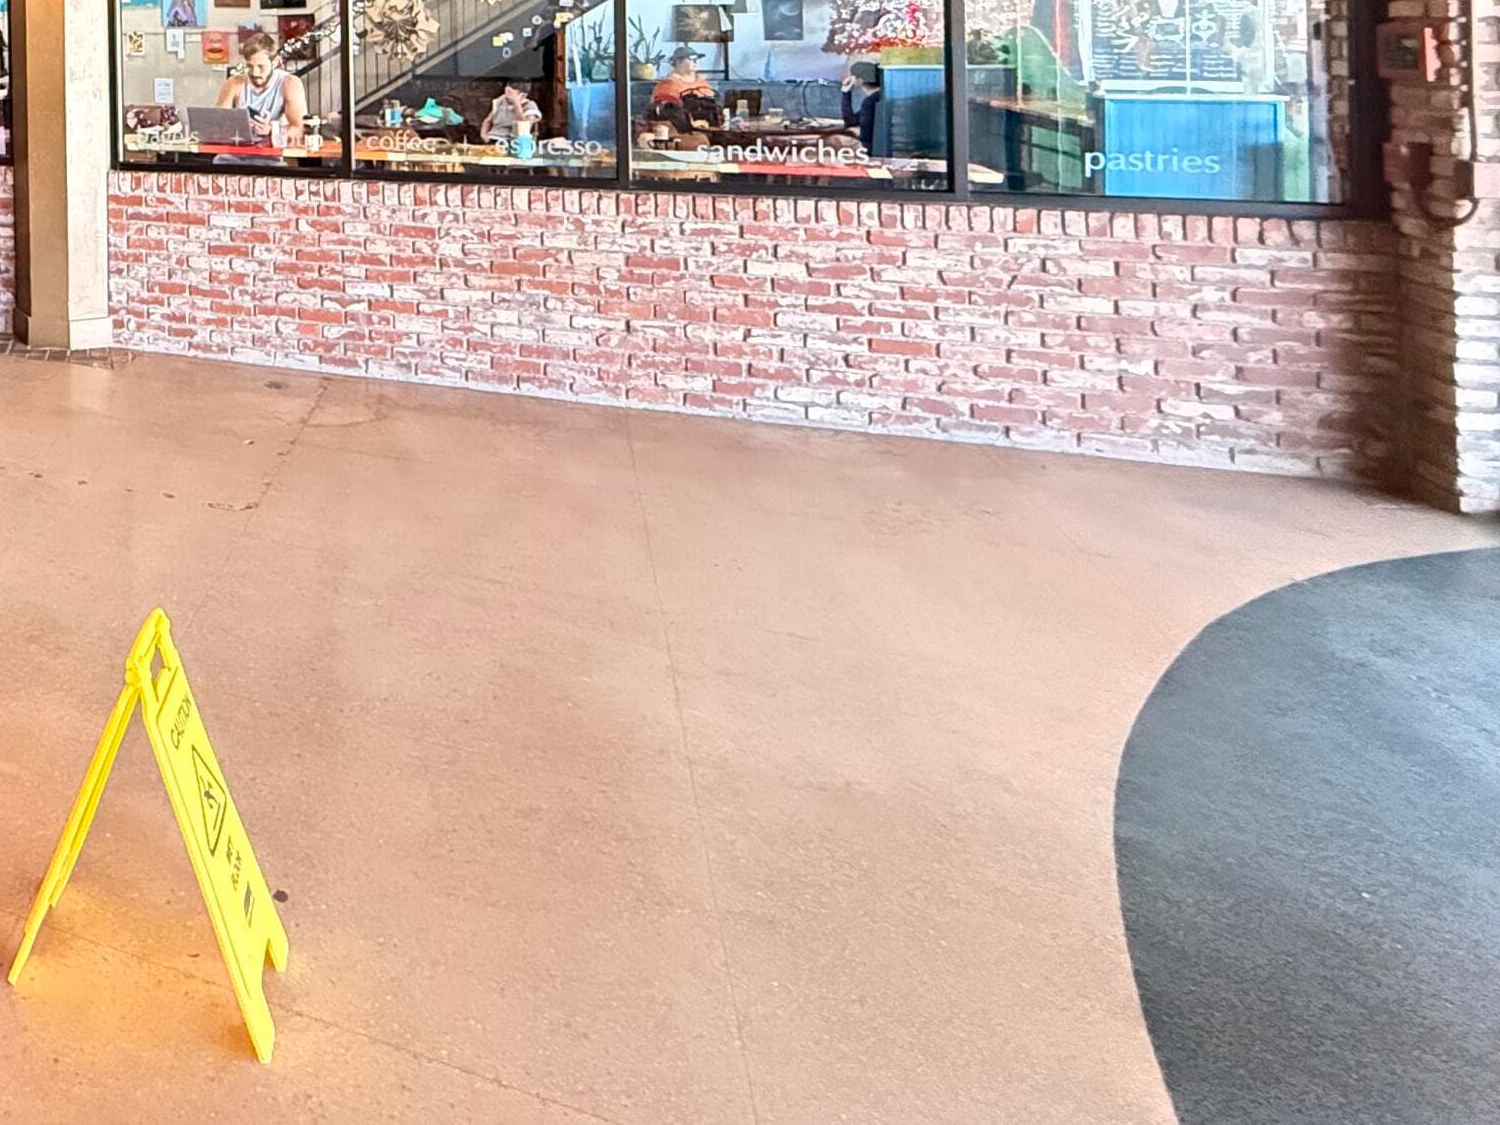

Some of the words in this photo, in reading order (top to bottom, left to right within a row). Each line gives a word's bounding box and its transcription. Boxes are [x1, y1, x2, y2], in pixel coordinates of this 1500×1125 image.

[366, 130, 437, 153] coffee
[697, 138, 870, 165] sandwiches
[1084, 147, 1221, 178] pastries
